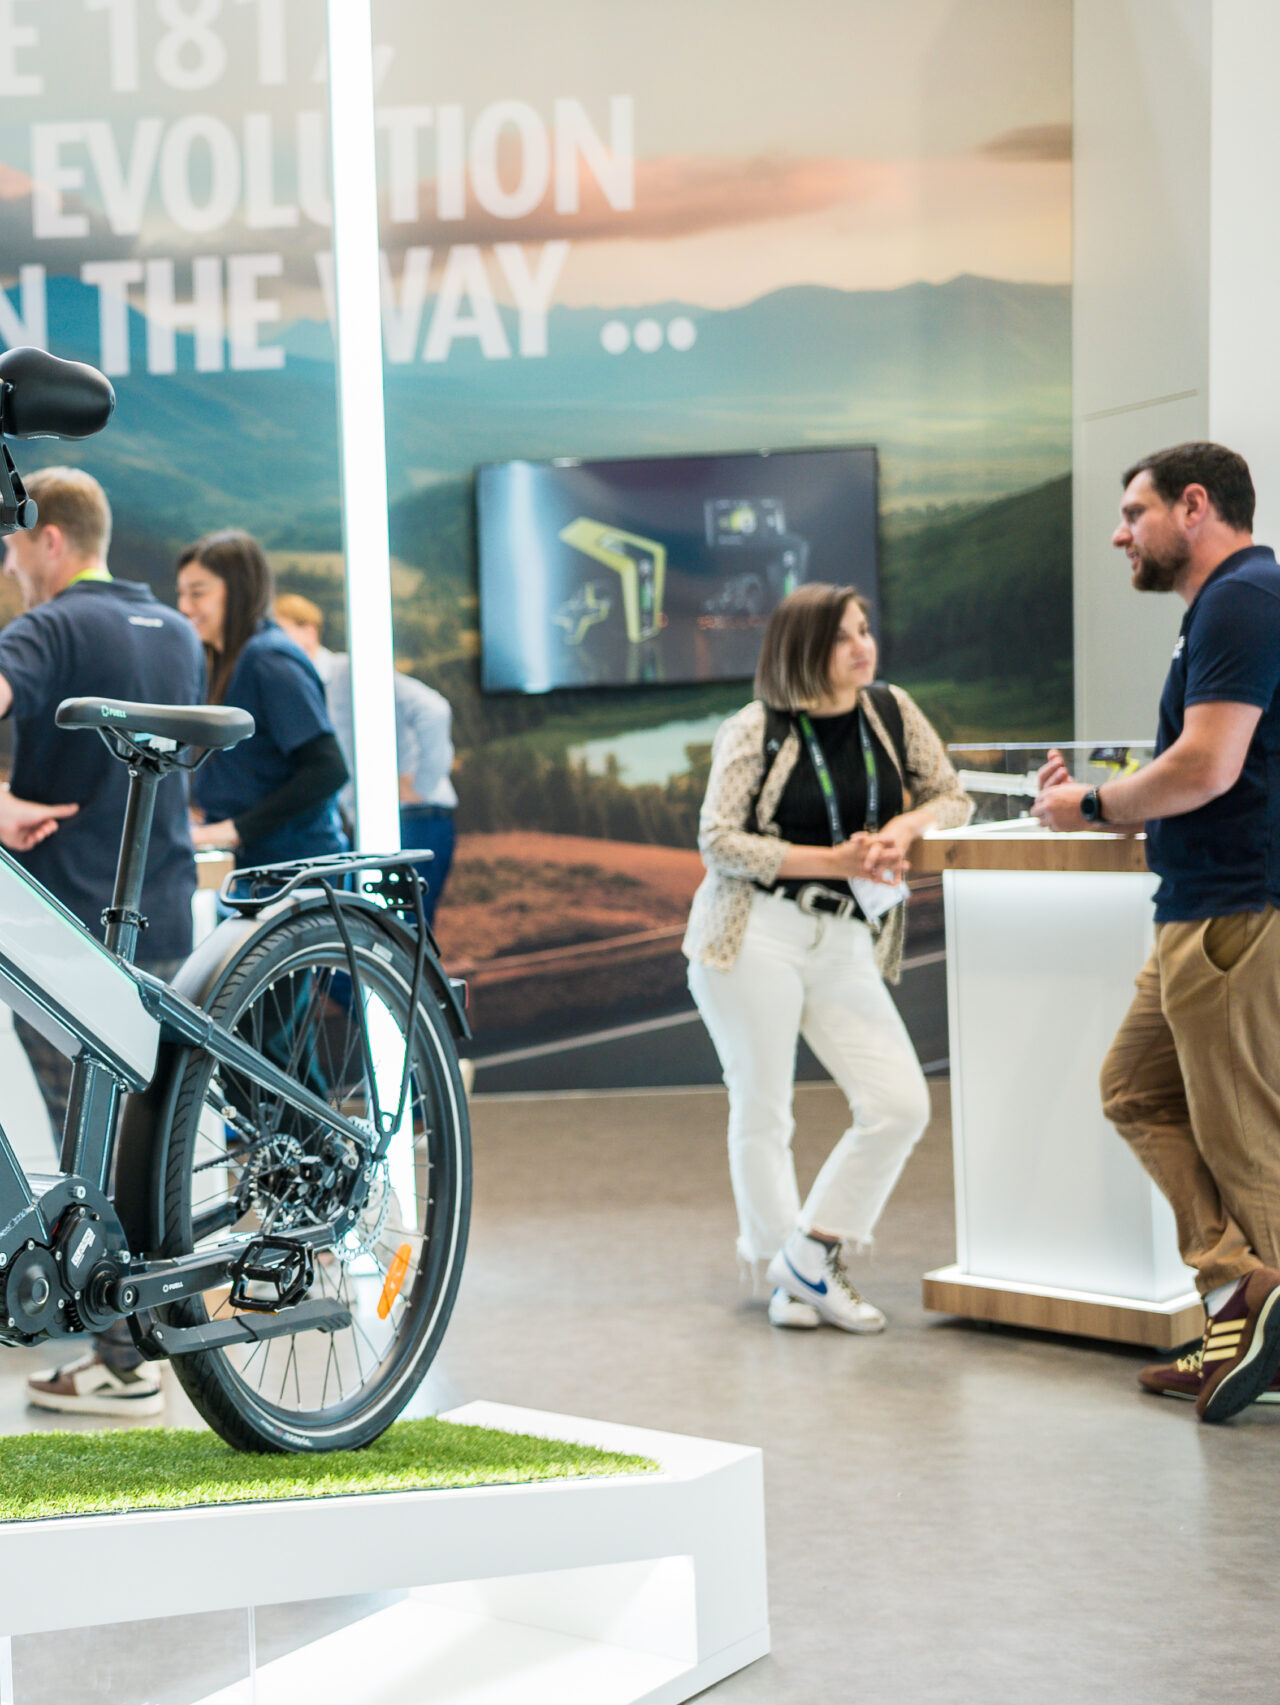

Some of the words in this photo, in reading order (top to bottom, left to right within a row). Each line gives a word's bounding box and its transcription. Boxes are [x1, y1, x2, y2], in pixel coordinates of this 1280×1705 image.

[90, 0, 396, 96] 181,
[81, 253, 286, 377] THE
[314, 241, 571, 365] WAY
